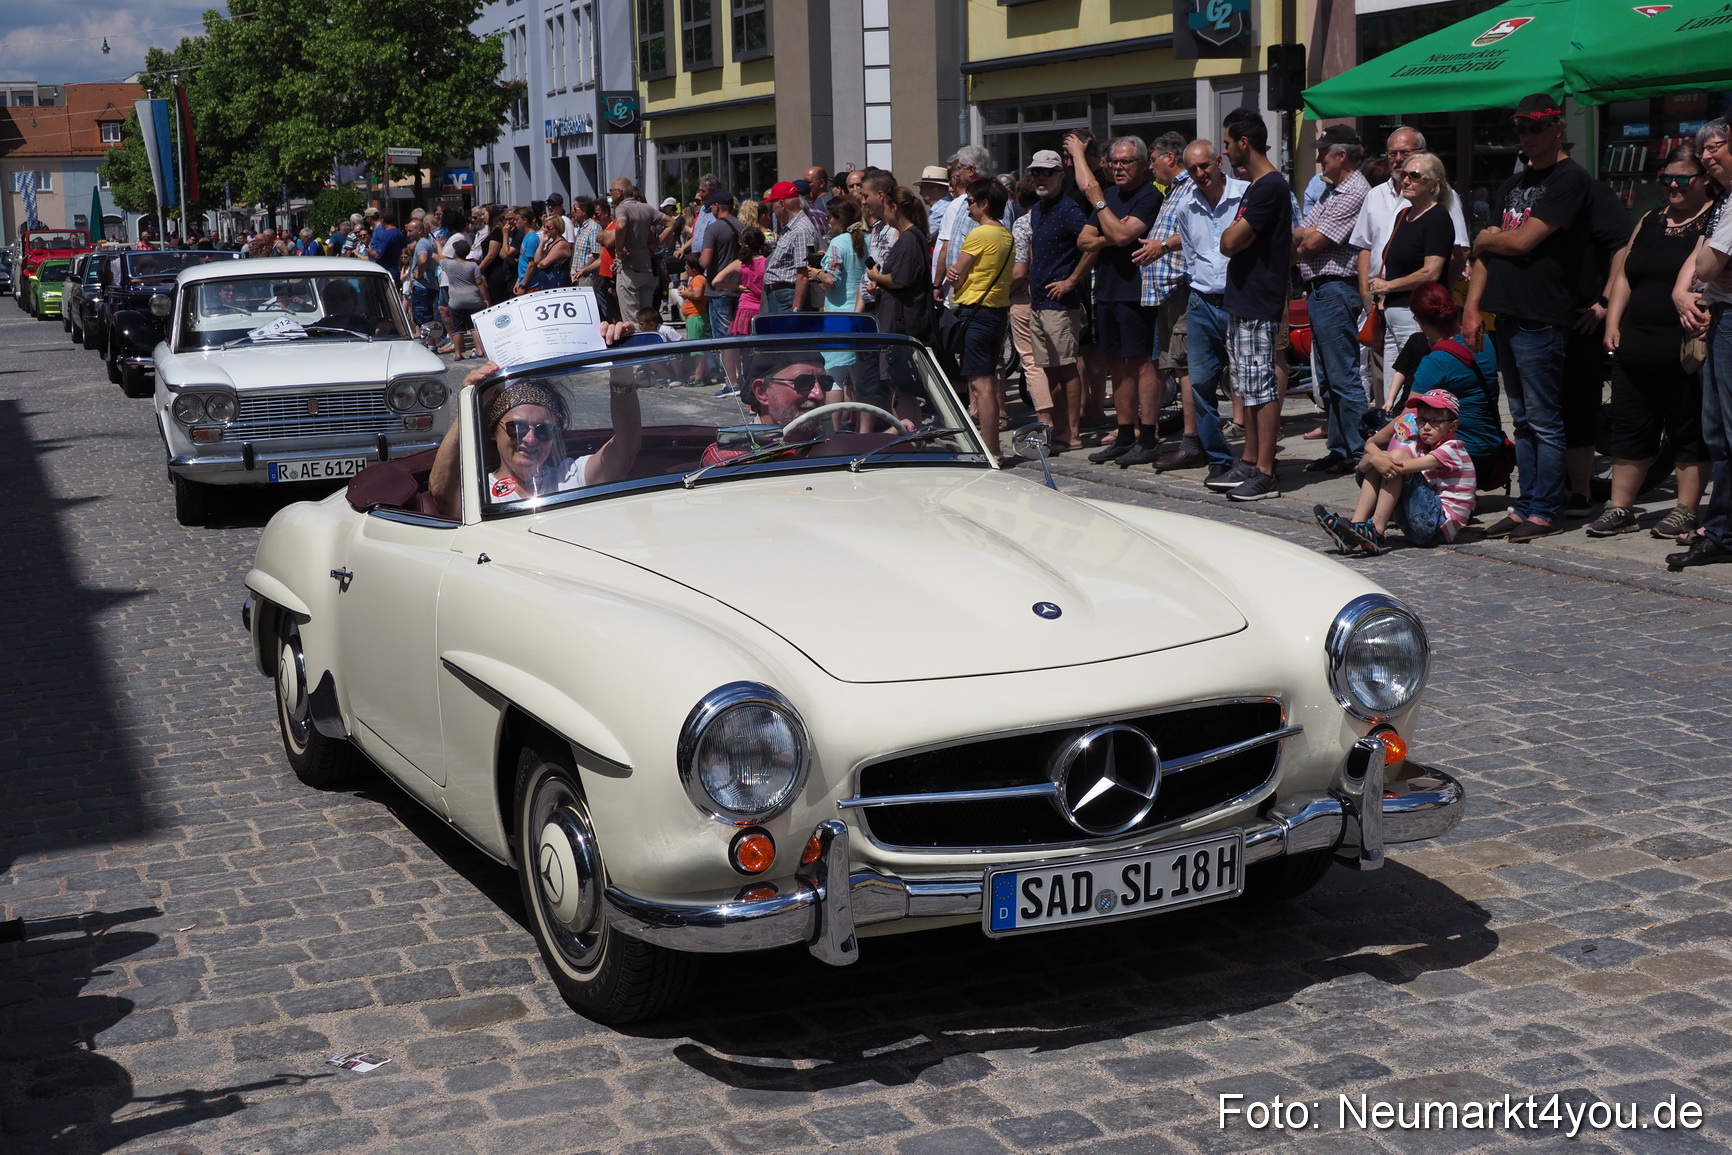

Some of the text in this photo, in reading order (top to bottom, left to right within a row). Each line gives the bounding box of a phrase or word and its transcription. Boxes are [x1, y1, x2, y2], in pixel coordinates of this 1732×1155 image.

[1423, 48, 1509, 62] Neumarkter
[1389, 58, 1505, 77] Lammsbräu
[613, 102, 628, 120] G2
[535, 302, 577, 322] 376
[273, 319, 292, 330] 312
[278, 464, 289, 480] R
[301, 462, 322, 478] AE
[1020, 870, 1094, 918] SAD
[1121, 861, 1163, 906] SL
[999, 907, 1009, 919] D
